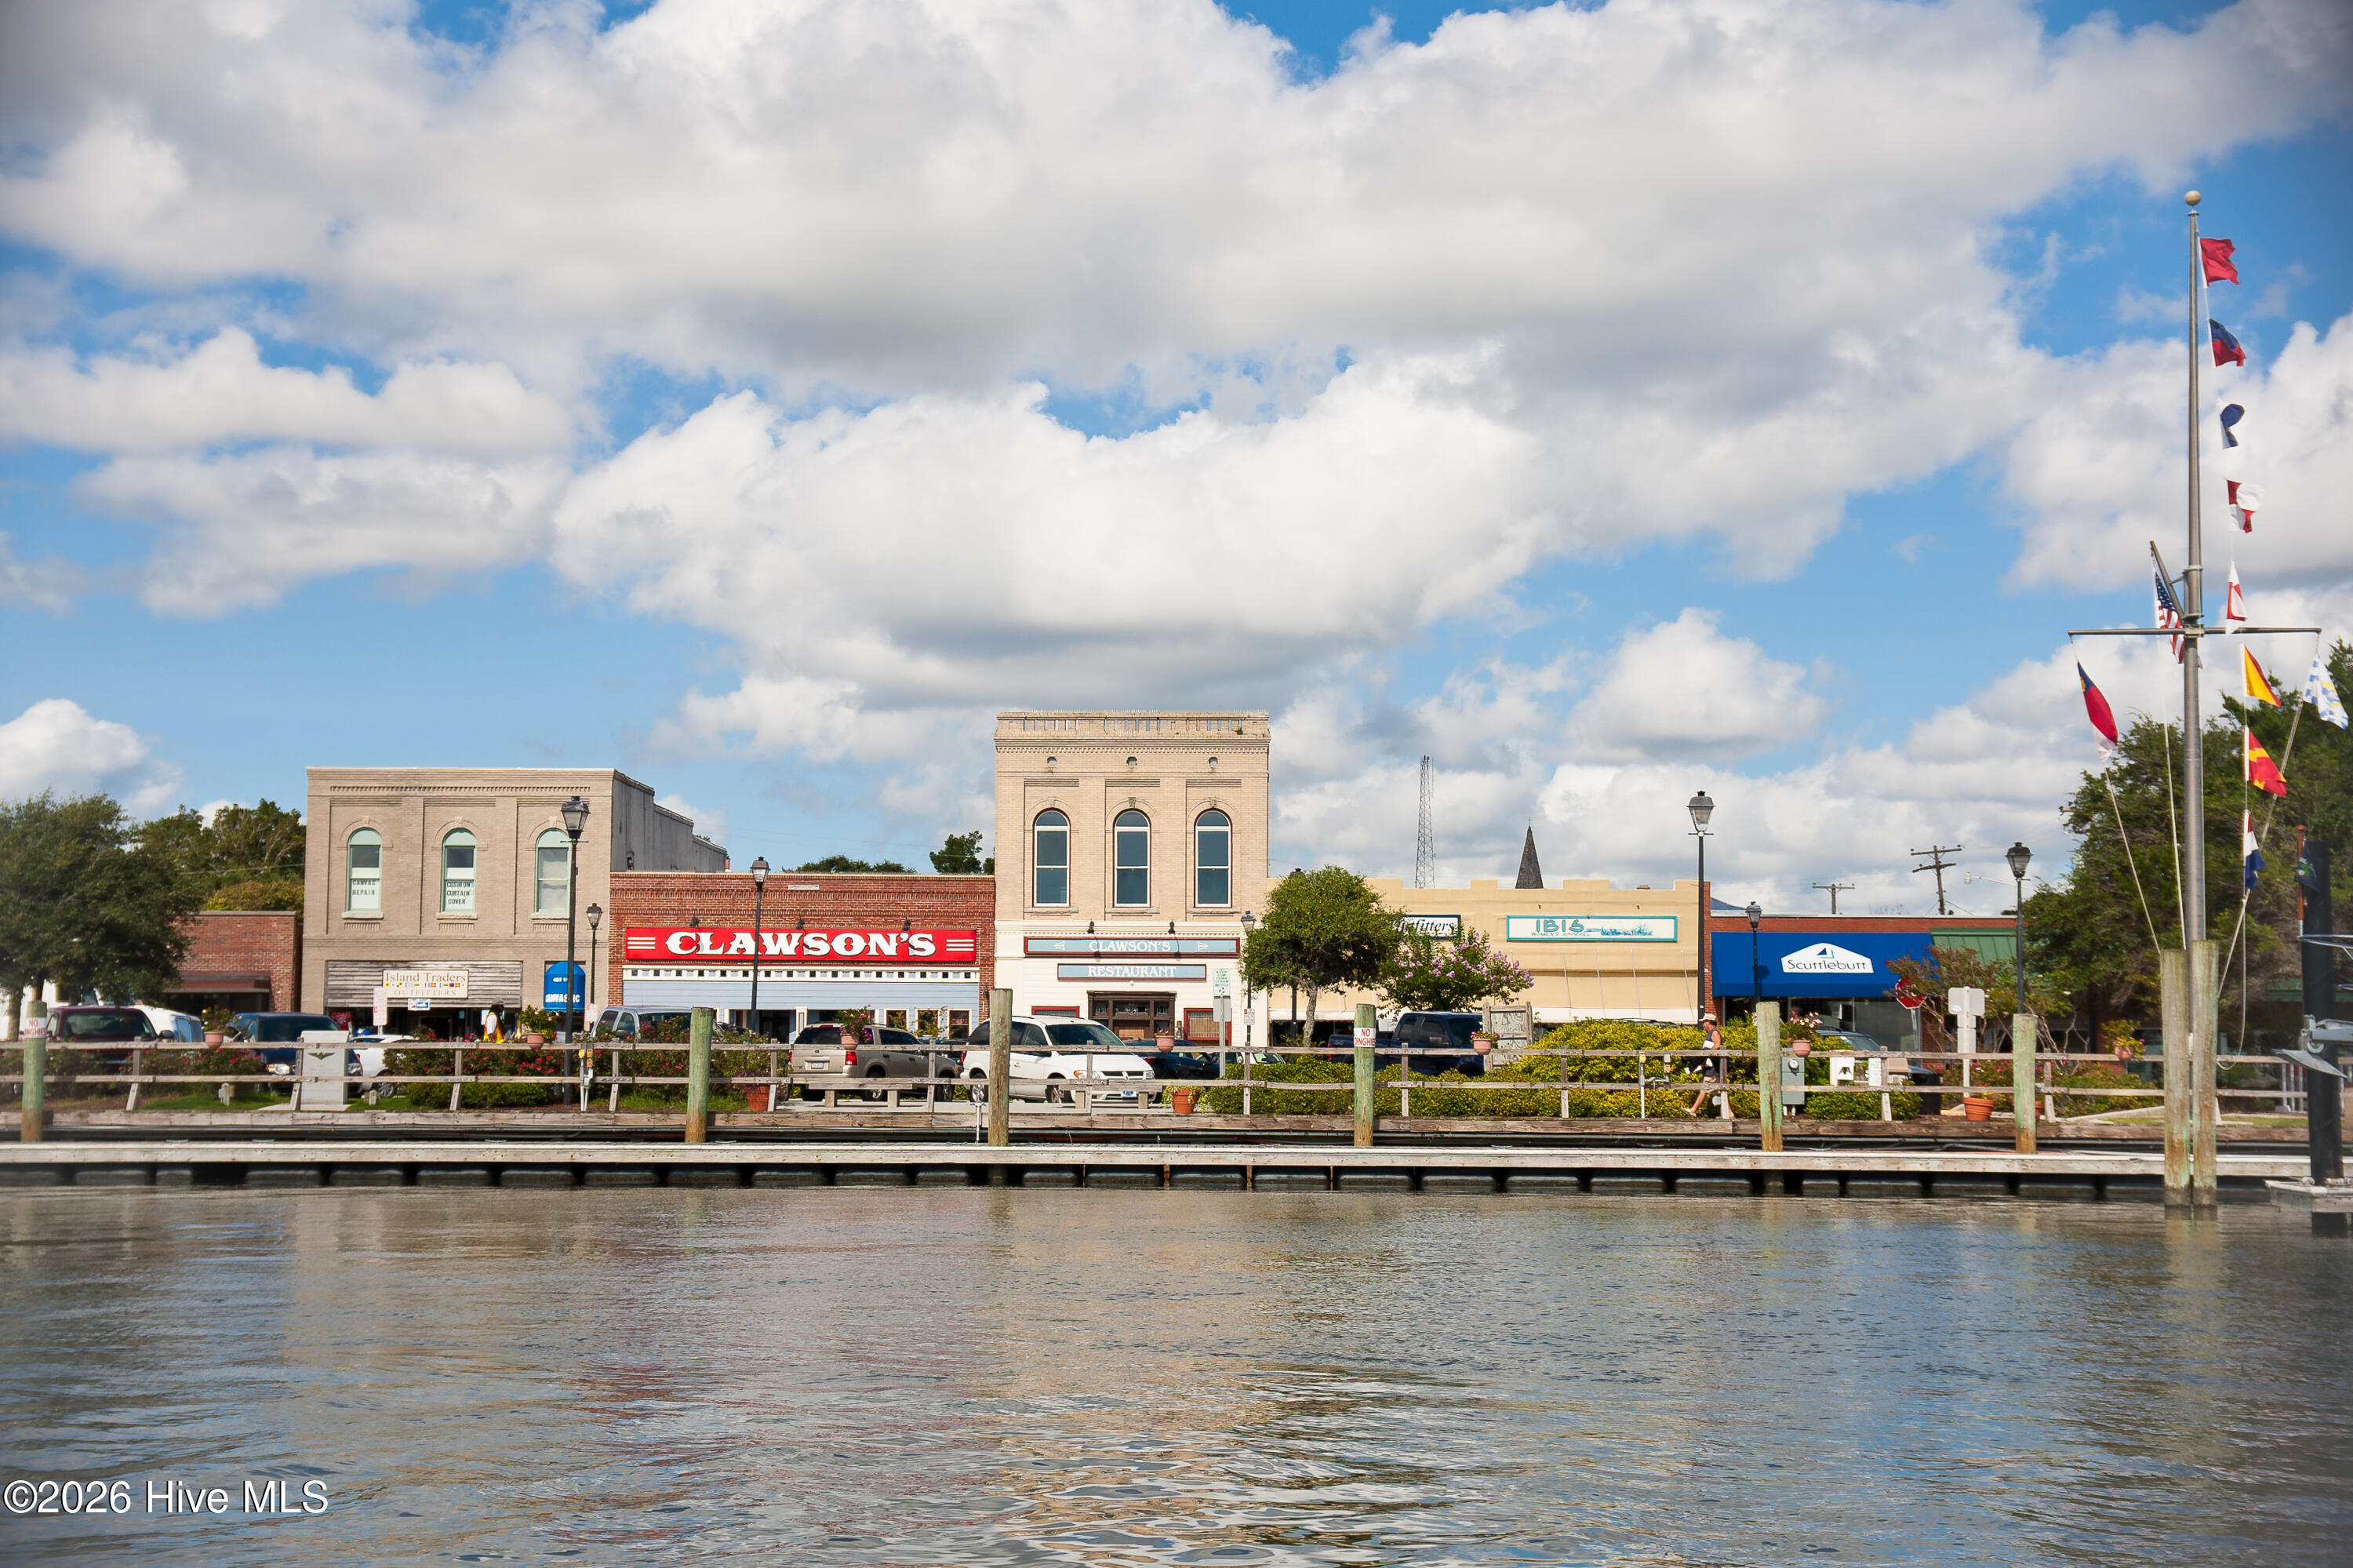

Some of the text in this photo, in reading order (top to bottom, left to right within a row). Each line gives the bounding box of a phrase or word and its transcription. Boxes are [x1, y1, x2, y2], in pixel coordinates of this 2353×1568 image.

[1536, 919, 1584, 933] IBIS
[665, 931, 936, 956] CLAWSON'S
[1089, 941, 1171, 952] CLAWSON'S
[1787, 959, 1866, 970] Scuttlebutt
[1088, 966, 1176, 977] RESTAURANT
[386, 973, 466, 982] Island Traders
